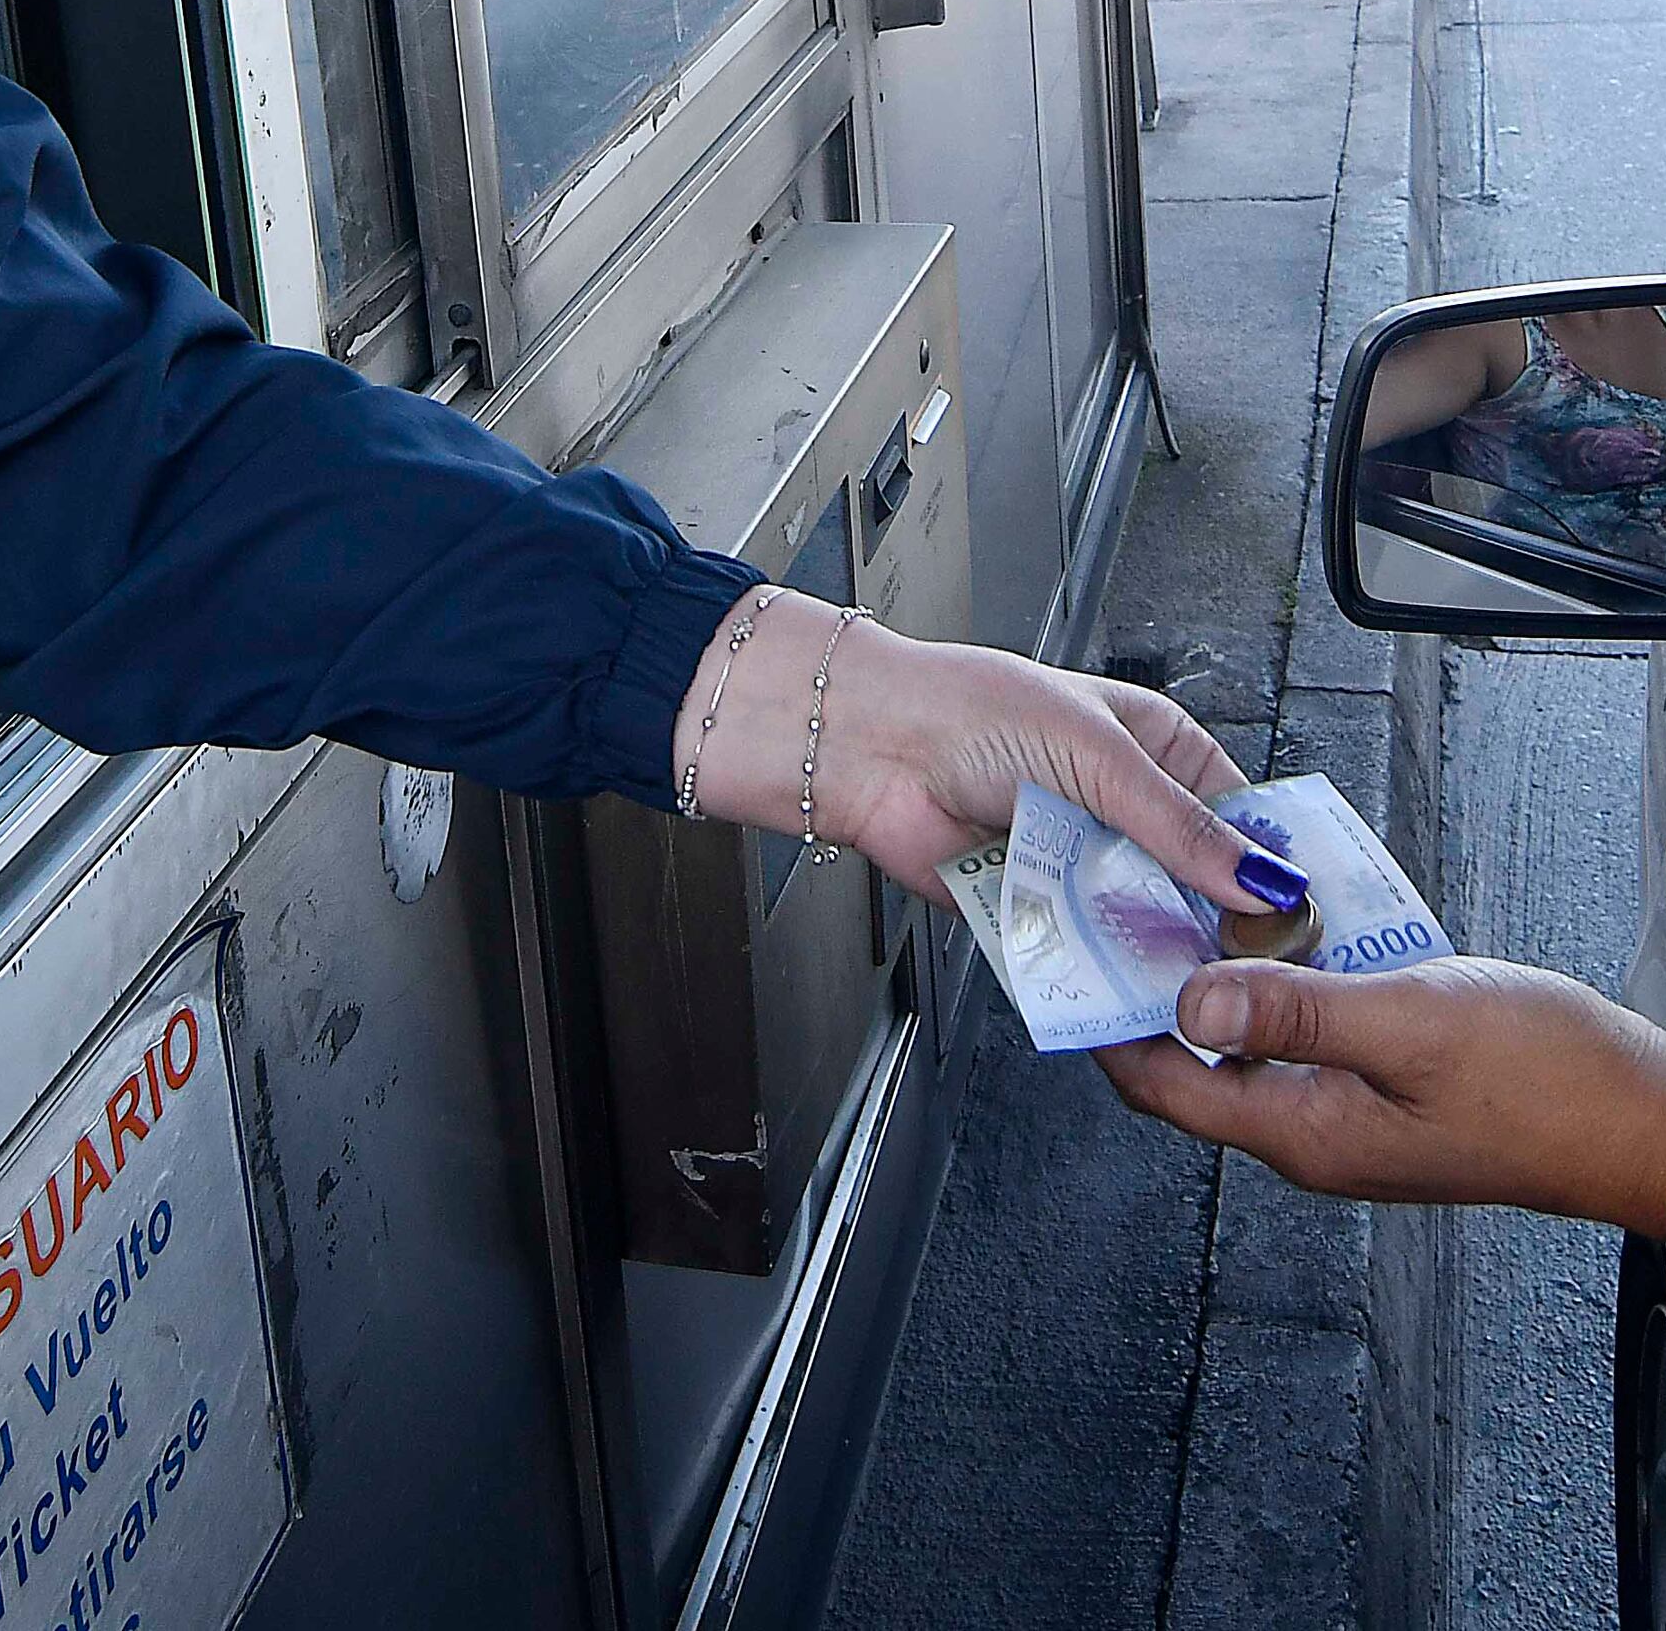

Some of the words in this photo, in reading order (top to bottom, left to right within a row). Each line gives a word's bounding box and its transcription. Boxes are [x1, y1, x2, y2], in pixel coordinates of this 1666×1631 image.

[1020, 802, 1085, 866] 2000
[1332, 921, 1433, 973] 2000
[24, 1198, 173, 1416] Vuelto
